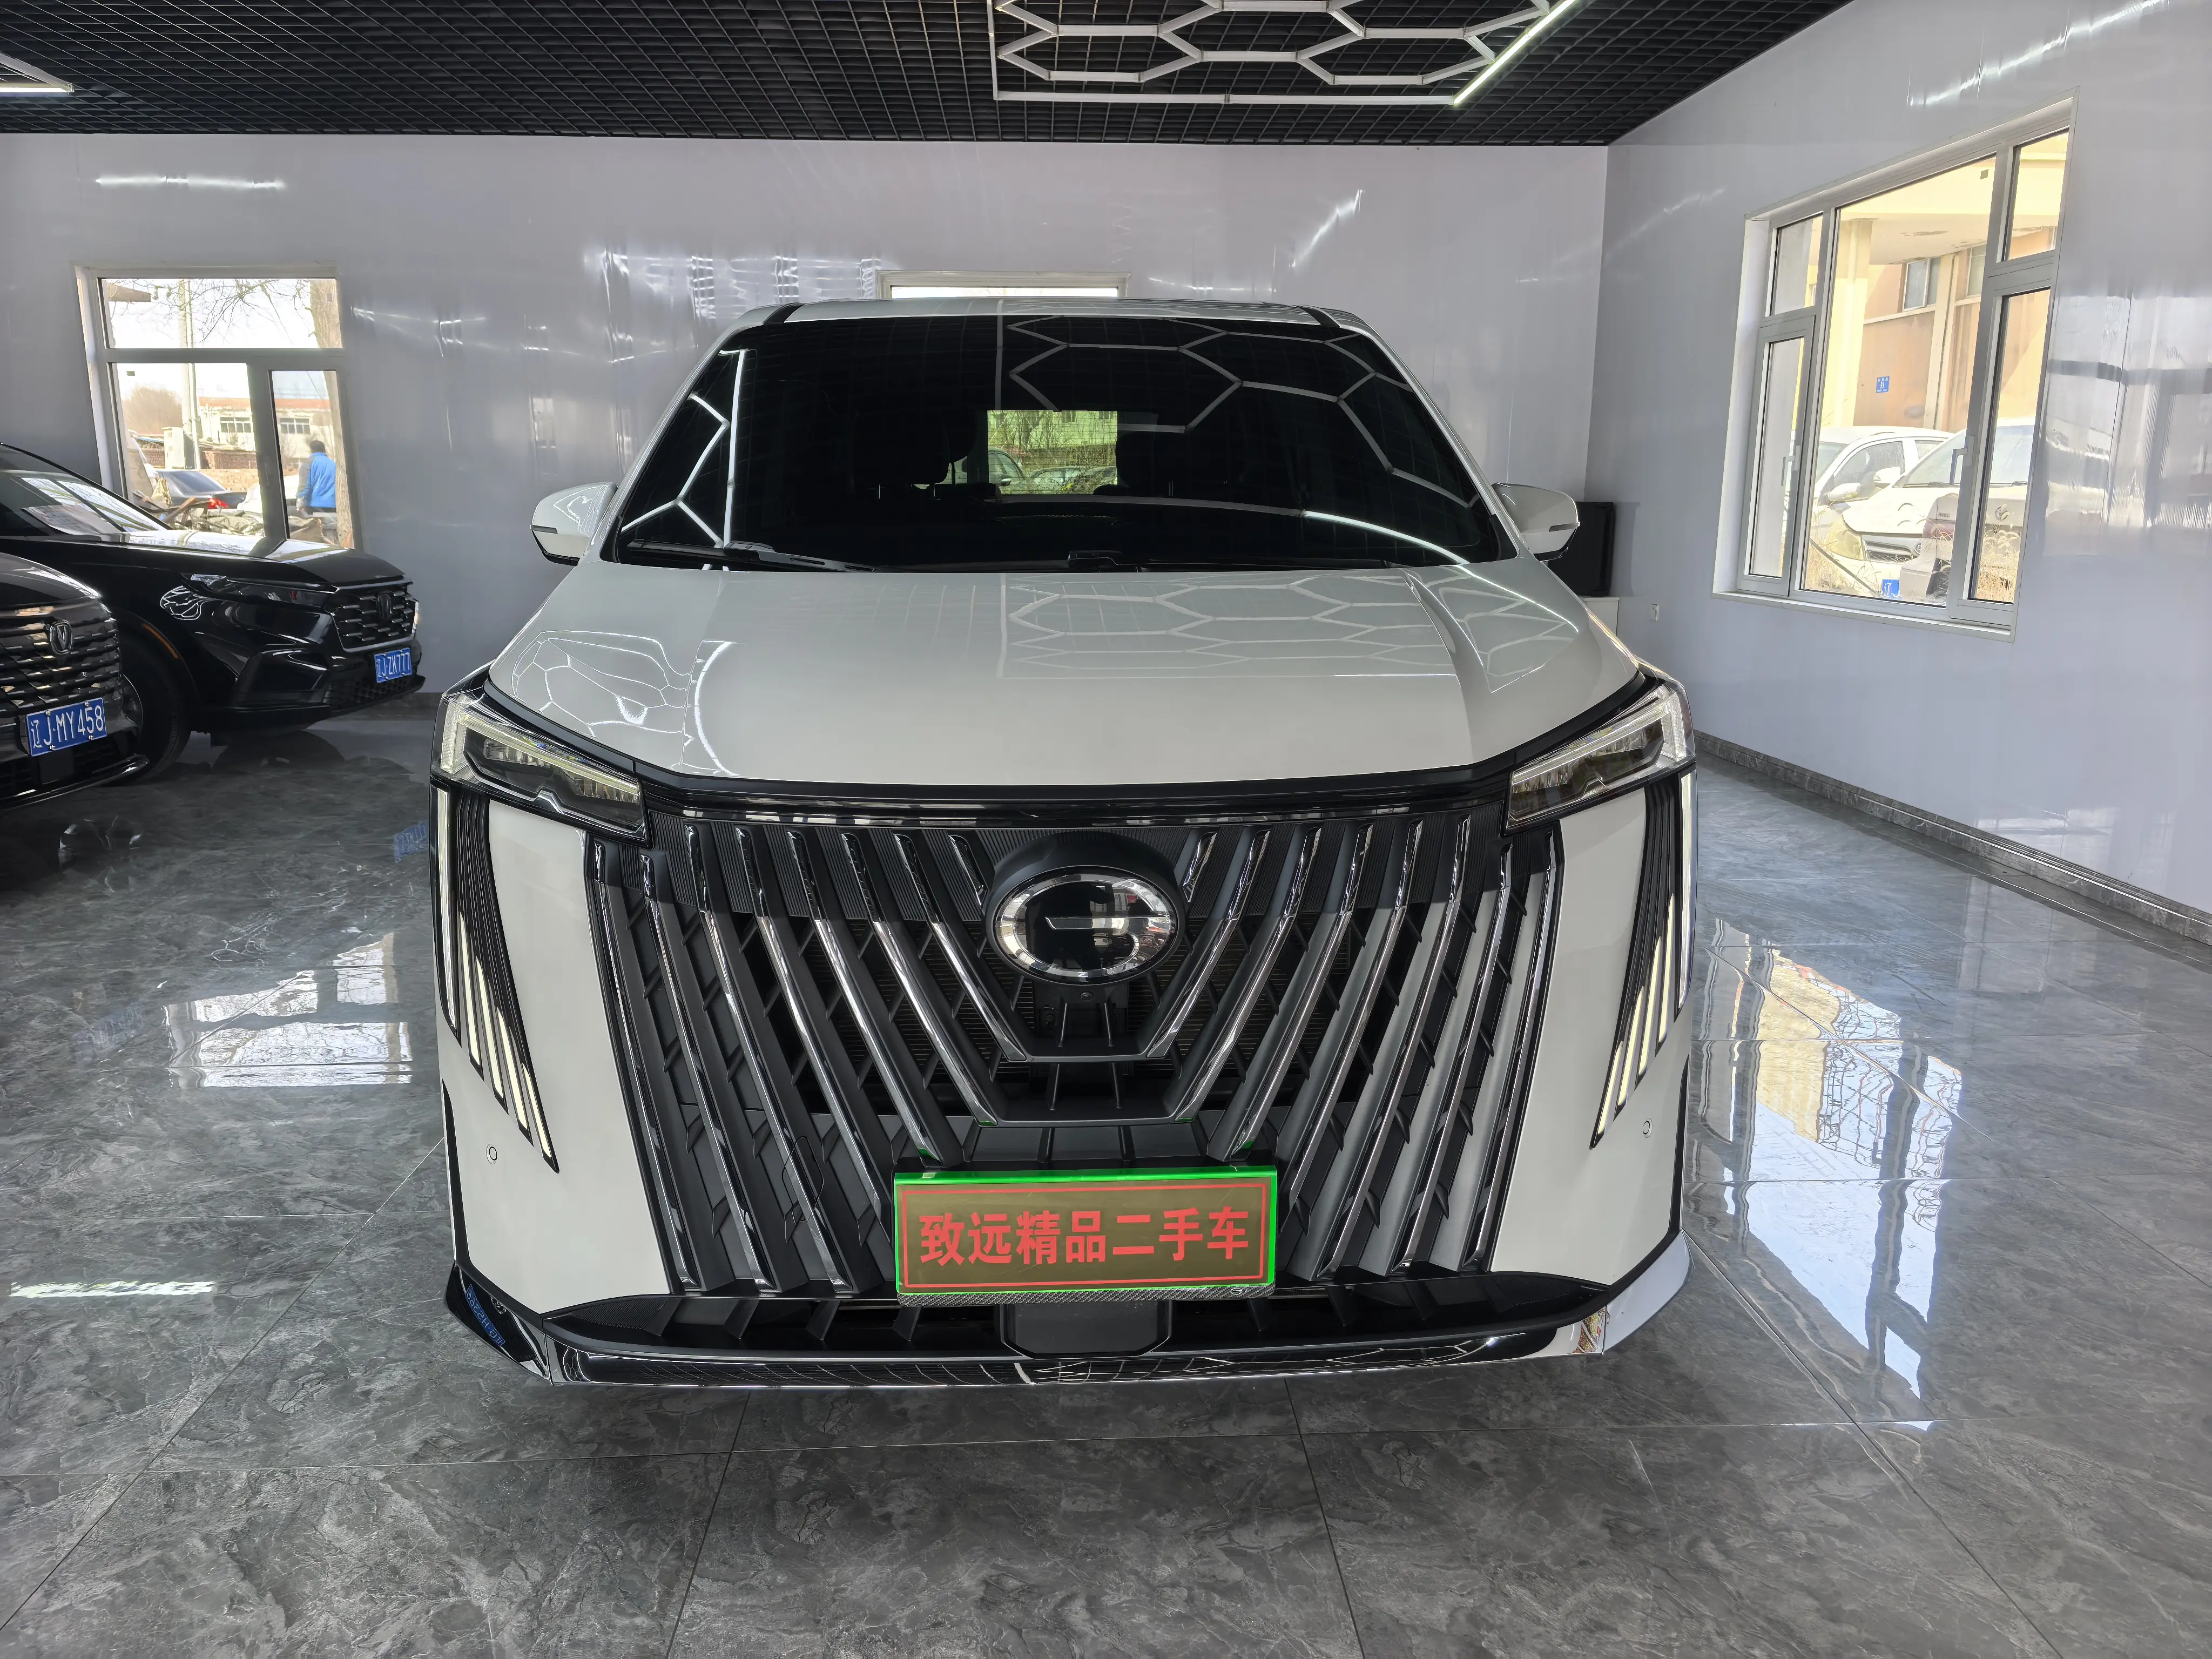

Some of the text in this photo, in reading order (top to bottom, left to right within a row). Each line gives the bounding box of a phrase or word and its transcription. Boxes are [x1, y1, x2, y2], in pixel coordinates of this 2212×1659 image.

[919, 1206, 1249, 1266] 致远精品二手车
